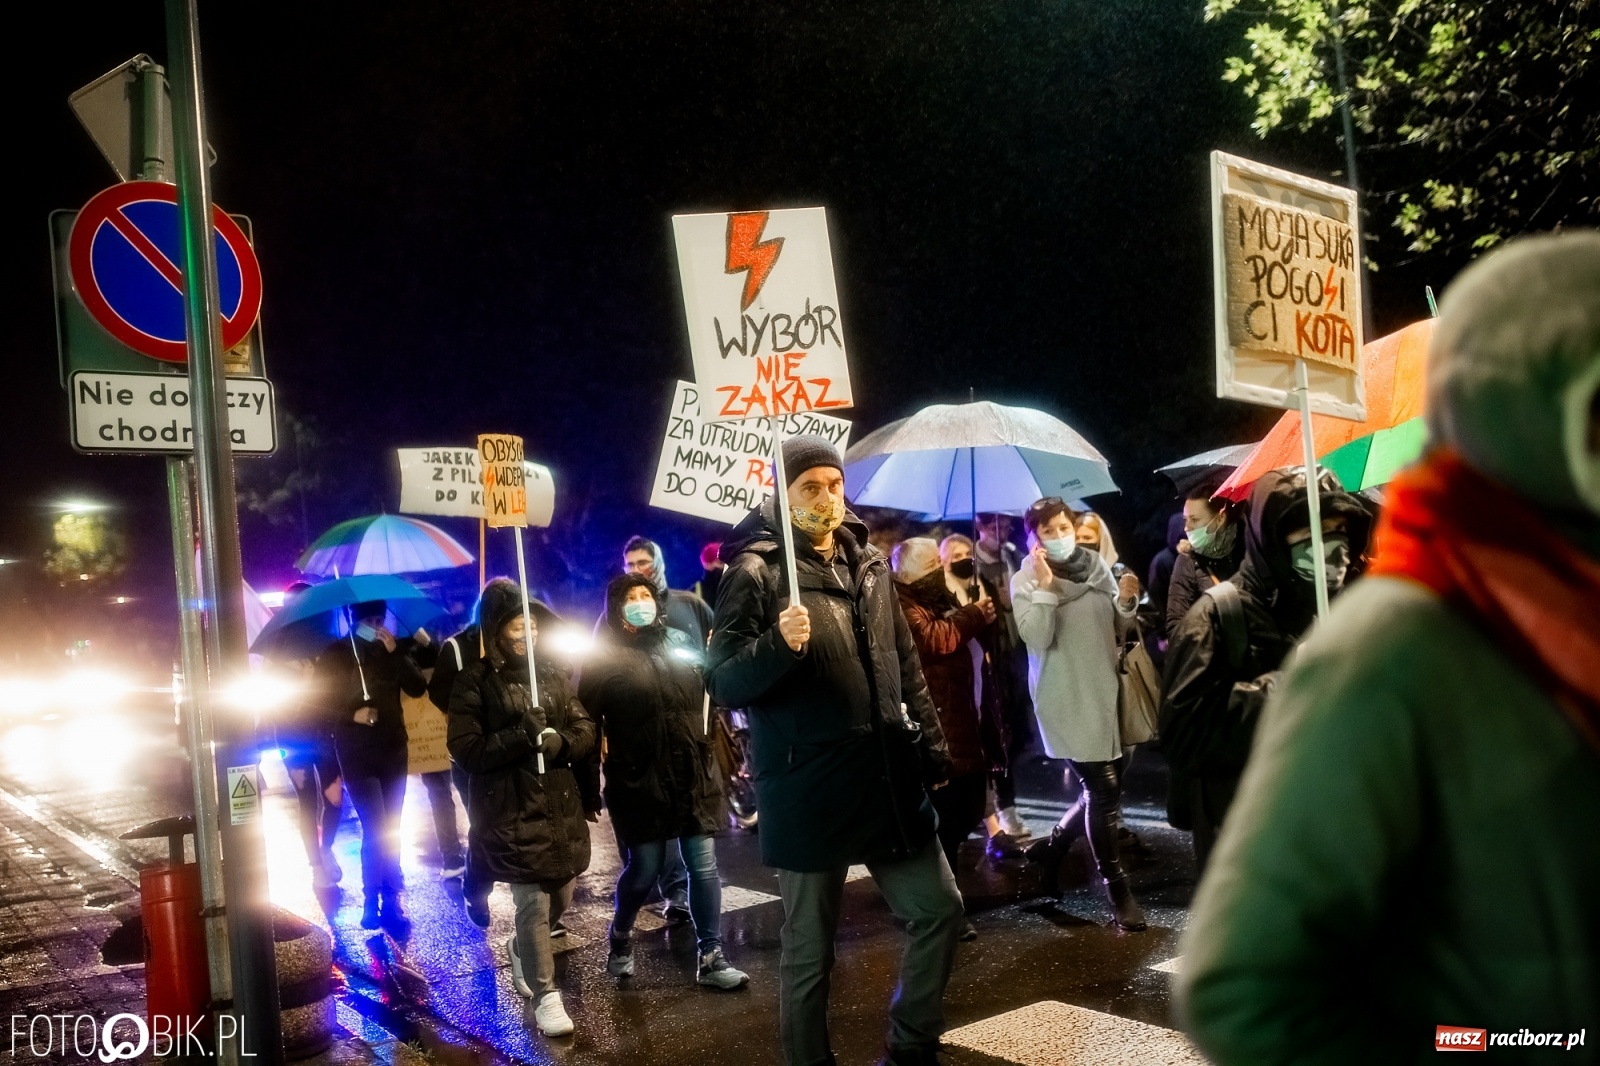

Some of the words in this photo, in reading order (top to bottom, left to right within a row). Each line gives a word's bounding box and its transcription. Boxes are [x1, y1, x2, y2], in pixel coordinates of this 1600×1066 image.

[1238, 205, 1311, 264] MOJA
[1314, 220, 1354, 271] SUKA
[713, 297, 843, 359] WYBÓR
[1244, 300, 1278, 342] CI
[1295, 309, 1355, 363] KOTA
[756, 352, 808, 383] NIE
[79, 380, 133, 406] Nie
[149, 382, 266, 415] doczy
[715, 378, 851, 417] ZAKAZ
[668, 416, 694, 440] ZA
[700, 424, 775, 459] UTRUDN
[422, 451, 475, 467] JAREK
[432, 467, 444, 481] Z
[673, 445, 737, 477] MAMY
[435, 489, 457, 502] DO
[493, 491, 507, 515] W
[663, 472, 697, 496] DO
[705, 482, 769, 510] OBAL
